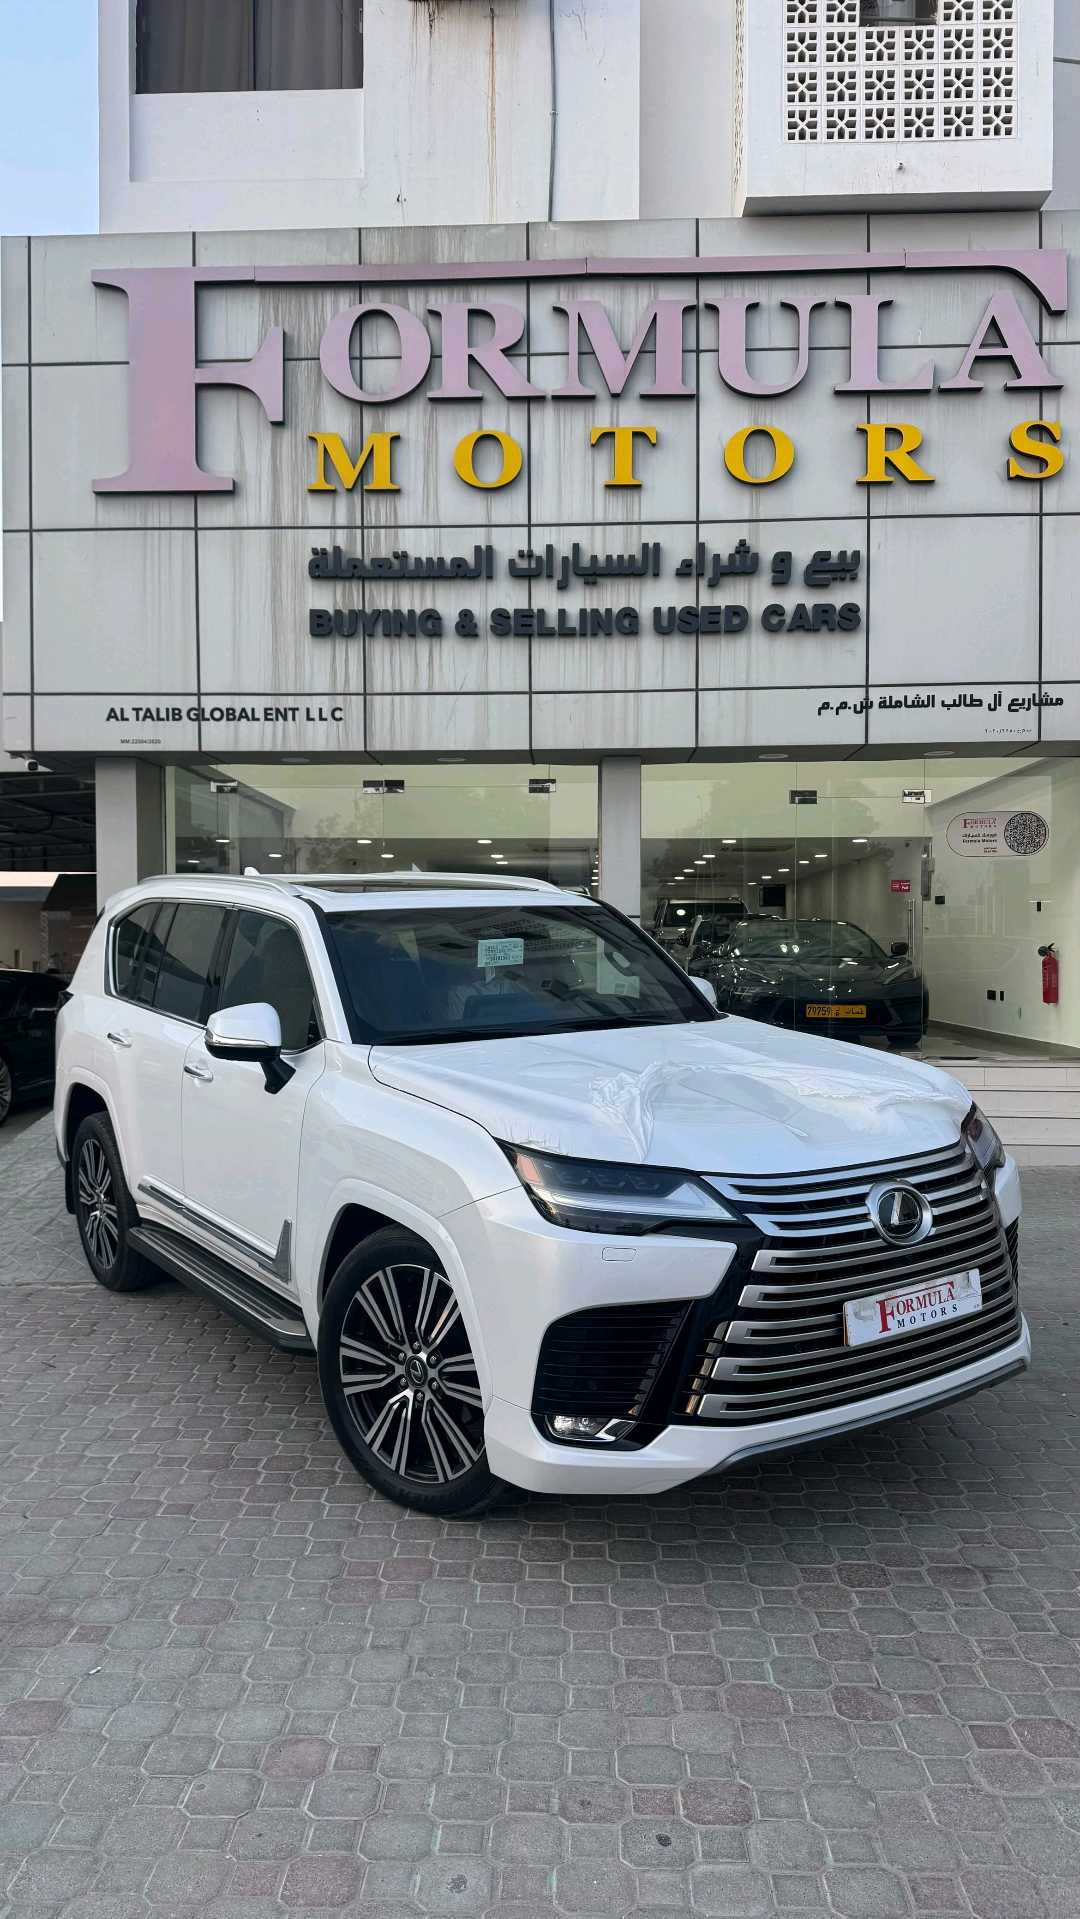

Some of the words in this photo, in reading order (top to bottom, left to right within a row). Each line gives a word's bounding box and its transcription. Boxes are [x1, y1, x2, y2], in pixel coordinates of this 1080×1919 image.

[91, 248, 1068, 493] FORMULA
[308, 421, 1065, 491] MOTORS
[307, 544, 494, 582] المستعملة
[508, 541, 661, 589] السيارات
[675, 539, 760, 588] شراء
[771, 551, 793, 587] و
[803, 549, 861, 588] بيع
[308, 608, 443, 637] BUYING
[455, 608, 480, 637] &
[490, 606, 640, 636] SELLING
[652, 605, 749, 634] USED
[761, 603, 862, 632] CARS
[106, 707, 129, 722] AL
[132, 707, 183, 722] TALIB
[186, 707, 260, 722] GLOBAL
[263, 707, 300, 722] ENT
[878, 694, 936, 709] الشاملة
[941, 693, 983, 710] طالب
[987, 691, 1002, 711] آل
[1007, 692, 1064, 713] مشاريع
[876, 1281, 955, 1333] FORMULA
[897, 1303, 959, 1329] MOTORS
